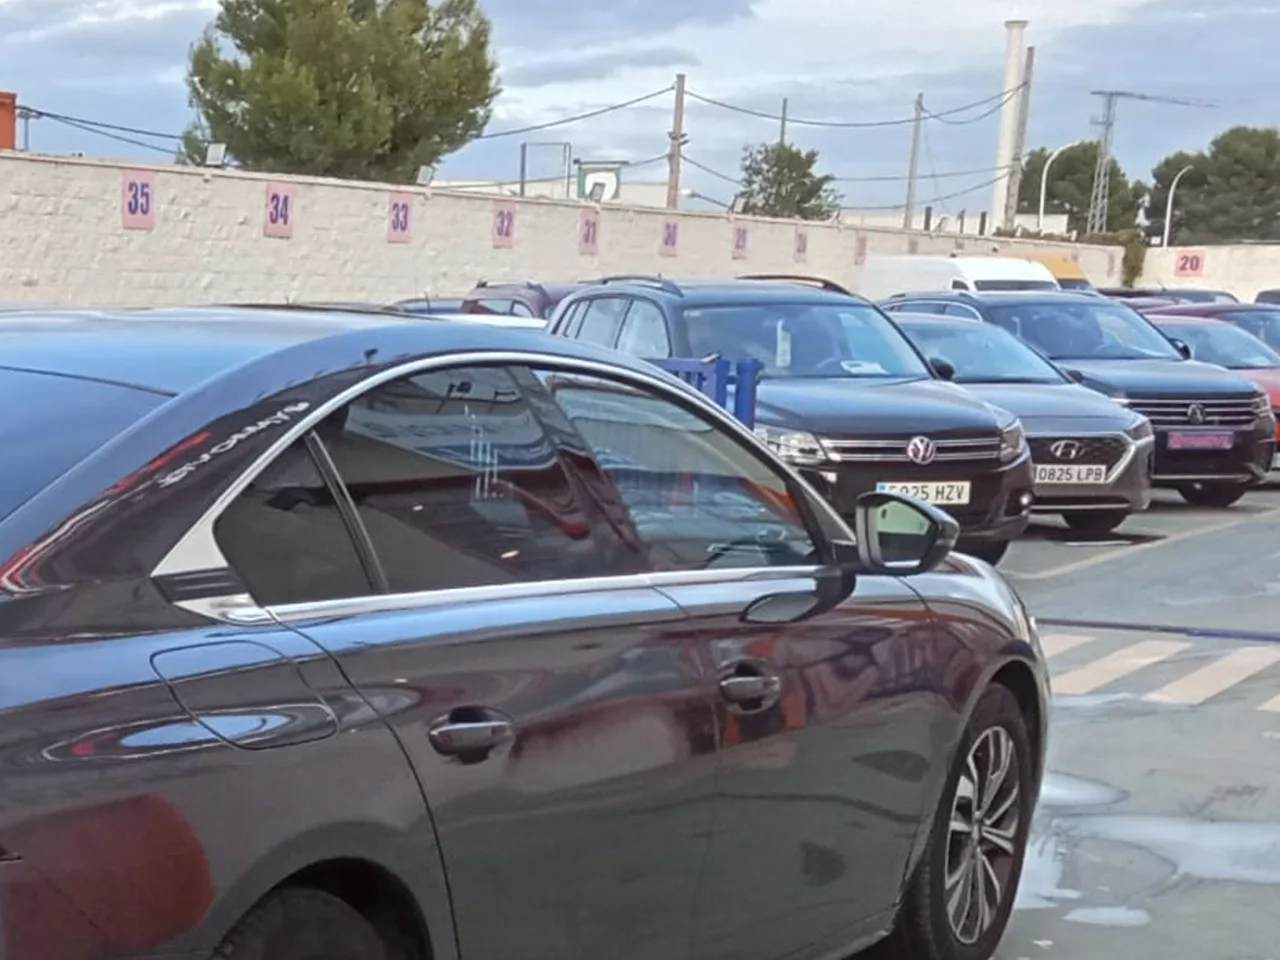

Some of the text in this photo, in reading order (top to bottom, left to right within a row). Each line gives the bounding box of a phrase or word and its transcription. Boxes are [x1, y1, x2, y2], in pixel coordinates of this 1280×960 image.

[127, 182, 150, 216] 35
[269, 194, 289, 225] 34
[391, 202, 408, 231] 33
[497, 210, 513, 237] 32
[1179, 255, 1200, 271] 20
[1039, 467, 1072, 481] 0825
